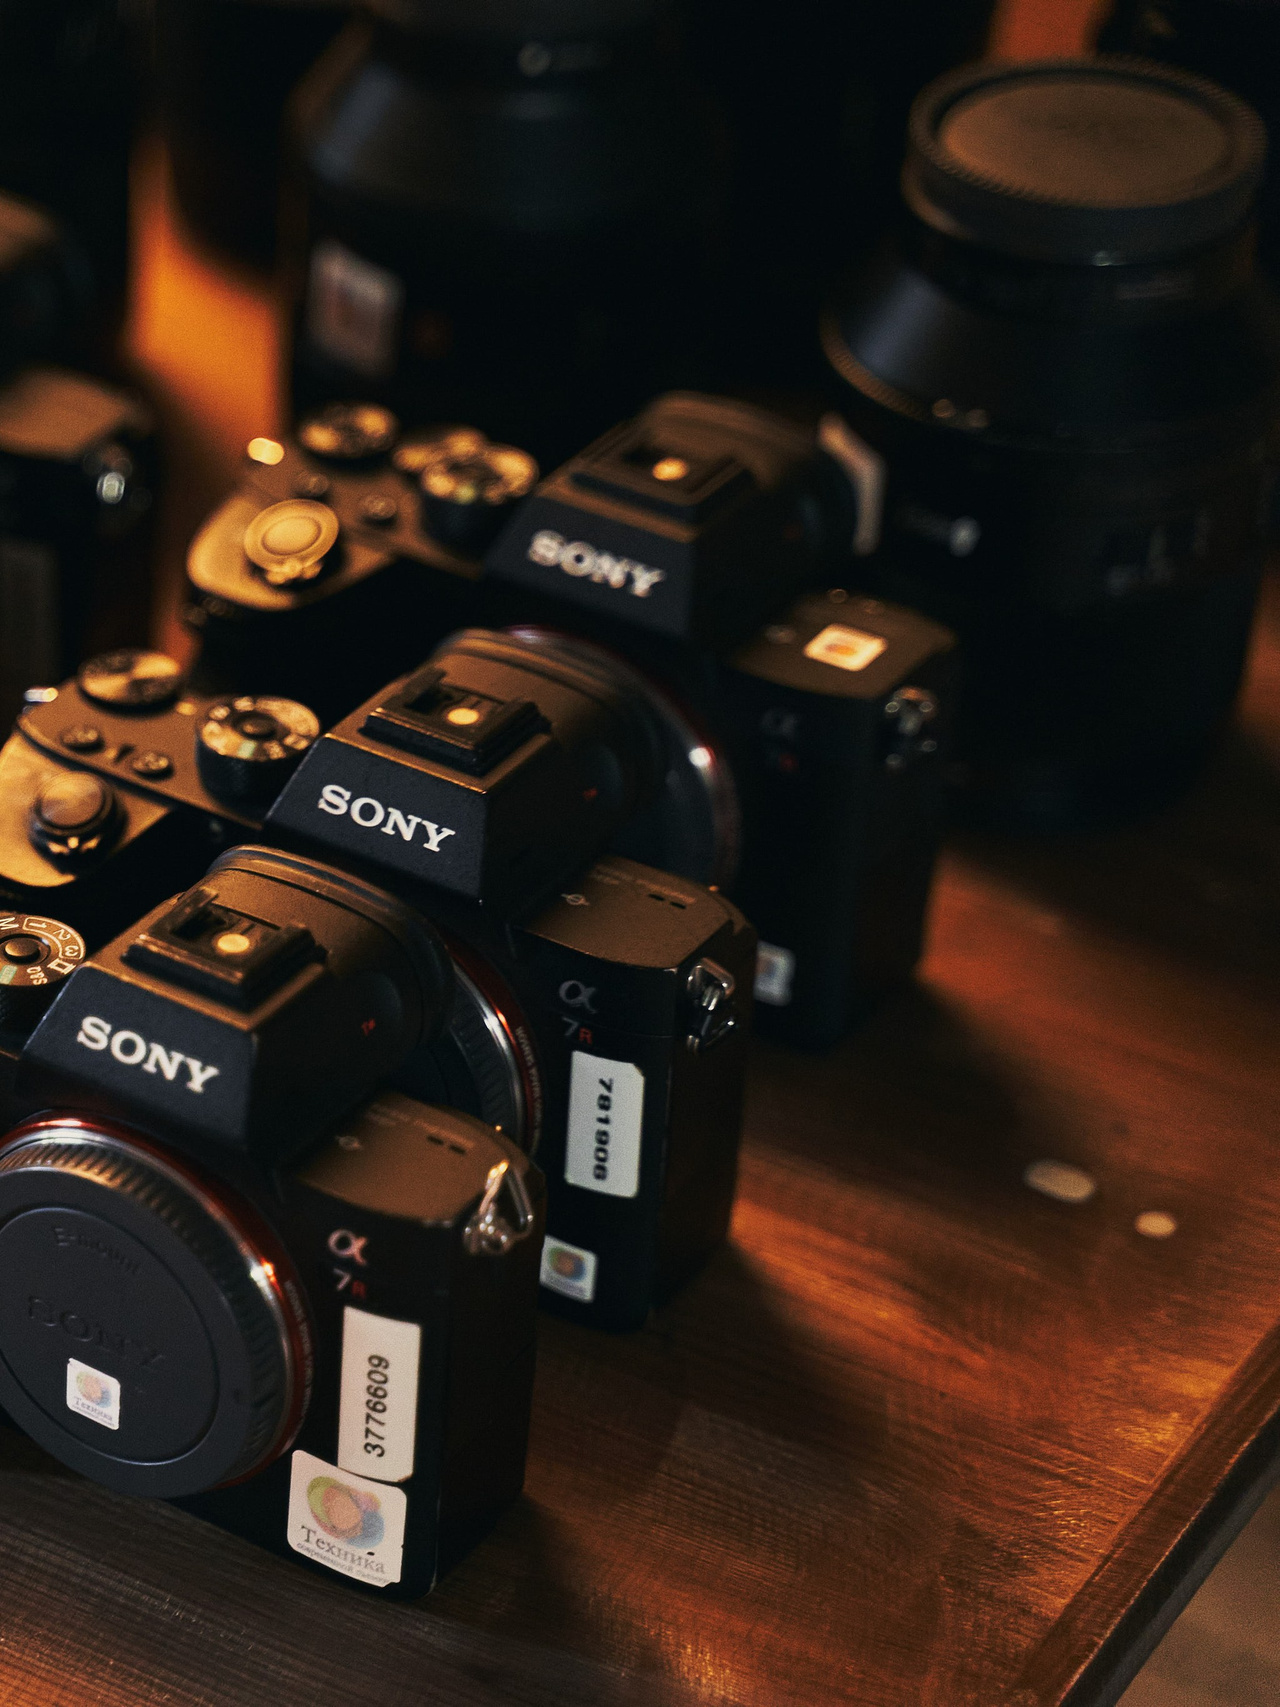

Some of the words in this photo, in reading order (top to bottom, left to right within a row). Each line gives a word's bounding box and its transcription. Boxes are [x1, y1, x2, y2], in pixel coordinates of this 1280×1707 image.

[527, 528, 667, 599] SONY
[317, 784, 456, 852] SONY
[29, 921, 47, 929] 1
[53, 929, 70, 941] 2
[64, 945, 79, 957] 3
[76, 1015, 220, 1094] SONY
[593, 1077, 614, 1182] 781906
[363, 1355, 390, 1458] 3776609
[301, 1525, 385, 1574] Техника
